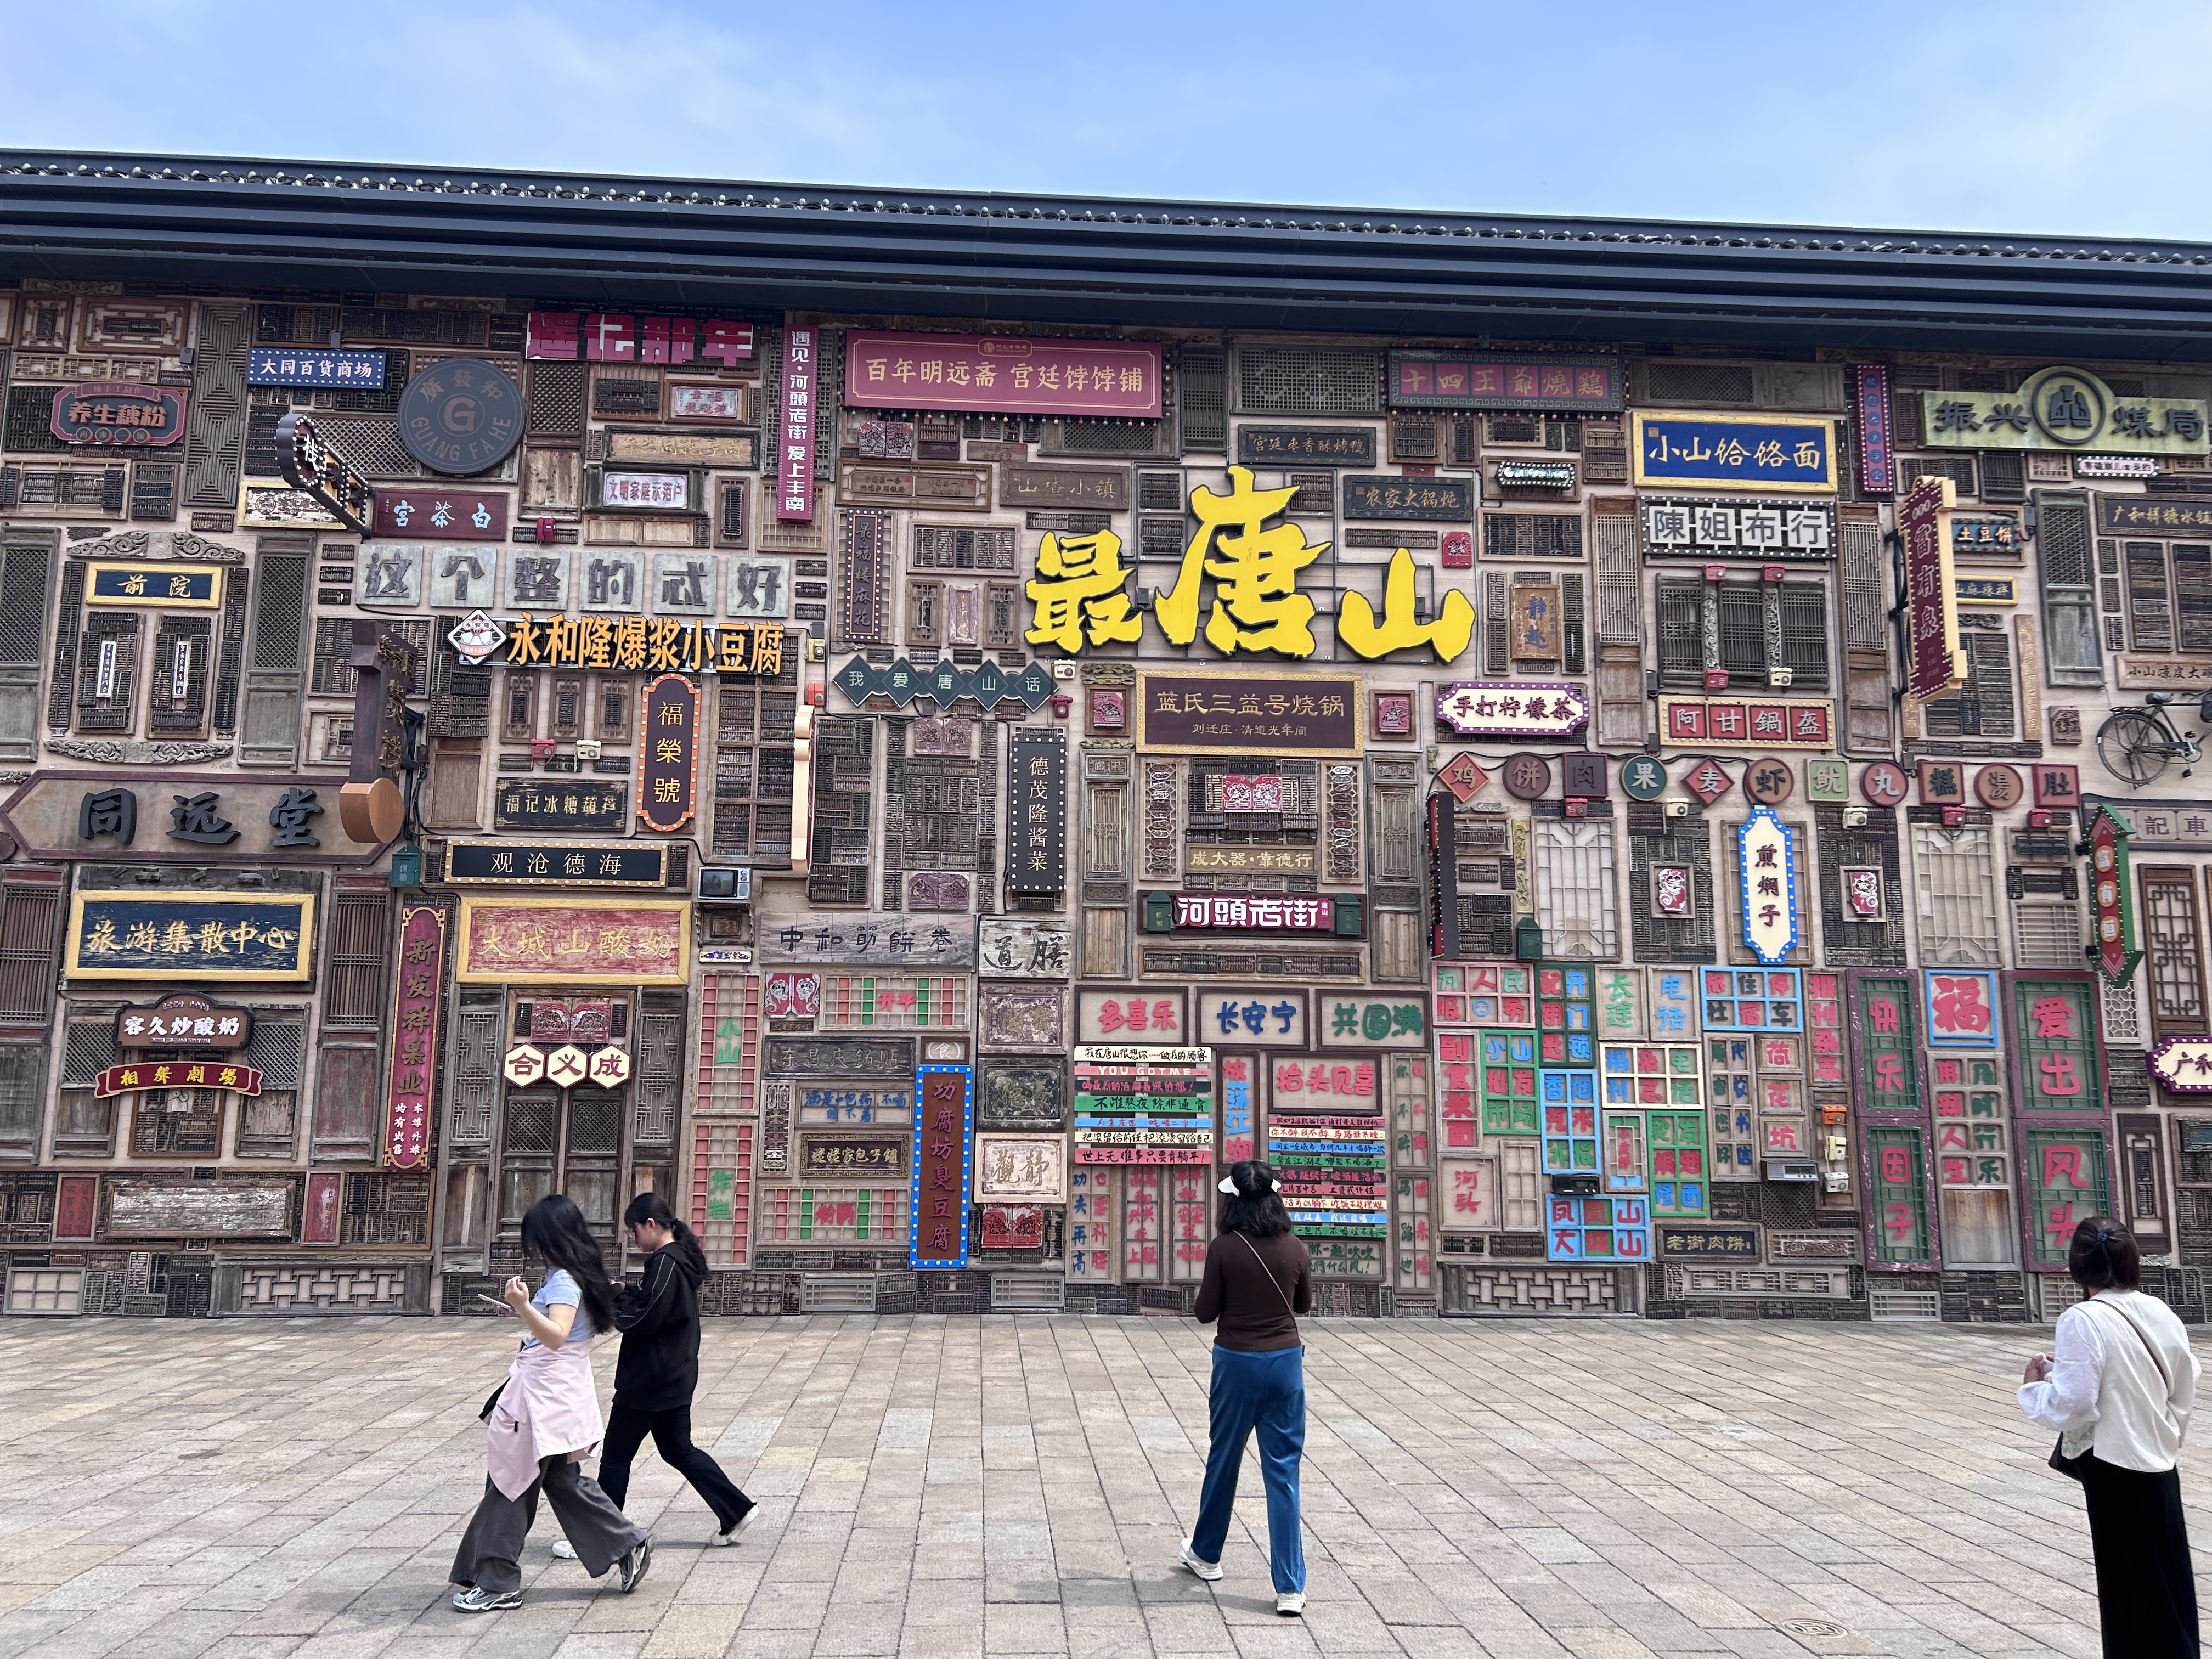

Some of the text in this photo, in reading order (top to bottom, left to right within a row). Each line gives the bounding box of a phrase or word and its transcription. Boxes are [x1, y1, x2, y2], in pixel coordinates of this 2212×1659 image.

[261, 359, 373, 379] 大同百货商场
[865, 357, 1143, 393] 百年明远斋 宫廷饽饽铺
[69, 401, 167, 428] 养生藕粉
[443, 397, 476, 432] G
[1934, 400, 2204, 440] 振兴煤局
[411, 416, 460, 462] GUANG
[1252, 433, 1366, 455] 宫廷枣香酥烤鸭
[607, 478, 683, 503] 文明家庭示范户
[785, 445, 807, 512] 爱上丰南
[1018, 476, 1118, 499] 山楂小镇
[1654, 509, 1822, 545] 陳姐布行
[1957, 526, 2014, 545] 土豆饼
[1024, 464, 1476, 664] 最唐山
[116, 573, 192, 598] 前院
[1913, 523, 1939, 641] 富有泉
[507, 610, 786, 674] 永和隆爆浆小豆腐
[847, 669, 1042, 693] 我爱唐山话
[1154, 691, 1345, 719] 蓝氏三益号烧锅
[1453, 695, 1576, 720] 手打柠檬茶
[1675, 709, 1824, 736] 阿甘鍋盔
[1452, 766, 1477, 789] 鸡
[1512, 759, 1542, 788] 饼
[1573, 762, 1595, 788] 肉
[1632, 761, 1661, 790] 果
[1699, 767, 1724, 794] 麦
[1755, 768, 1787, 795] 虾
[1872, 768, 1900, 796] 丸
[1929, 767, 1959, 797] 糕
[2041, 772, 2074, 797] 肚
[78, 787, 326, 848] 同远堂
[505, 793, 618, 815] 福记冰糖葫芦
[1026, 756, 1050, 871] 德茂隆酱菜
[2126, 815, 2209, 837] 記車
[1754, 843, 1780, 928] 煎焖子
[86, 919, 295, 955] 旅游集散中心
[481, 924, 672, 961] 大城山酸奶
[1437, 968, 1523, 993] 为人民
[396, 936, 438, 1096] 新发祥果业
[876, 992, 917, 1013] 开平
[1098, 998, 1177, 1032] 多喜乐
[1539, 971, 1563, 1060] 配钥匙
[1566, 971, 1590, 1059] 开门锁
[1605, 972, 1635, 1028] 长途
[1656, 973, 1688, 1031] 电话
[1737, 973, 1760, 1025] 住宿
[1769, 974, 1793, 1027] 停车
[1932, 977, 1990, 1034] 福
[123, 1015, 240, 1037] 容久炒酸奶
[1216, 1000, 1297, 1035] 长安宁
[1331, 1002, 1424, 1040] 共圆满
[1810, 973, 1843, 1081] 报刊杂志
[716, 1017, 742, 1064] 小山
[781, 1046, 900, 1069] 东昌庆锅贴
[1486, 1037, 1532, 1062] 小山
[120, 1065, 237, 1087] 相聲劇場
[507, 1052, 627, 1078] 合义成
[1098, 1066, 1128, 1076] YOU
[1275, 1061, 1376, 1096] 抬头见喜
[1486, 1068, 1535, 1095] 批发
[1671, 1051, 1694, 1103] 电话
[1440, 1034, 1475, 1148] 副食米面
[1544, 1075, 1593, 1101] 香烟
[1765, 1041, 1797, 1151] 荷花坑
[1221, 1058, 1256, 1164] 放荡江湖
[1487, 1101, 1536, 1127] 市场
[1545, 1108, 1594, 1132] 汽水
[1869, 997, 1914, 1239] 快乐因子
[2033, 997, 2089, 1248] 爱出风头
[708, 1170, 736, 1221] 炸糕
[1455, 1170, 1482, 1212] 河头
[1073, 1171, 1087, 1275] 功夫再高
[1554, 1229, 1643, 1256] 大城山
[1666, 1234, 1746, 1251] 老街肉饼
